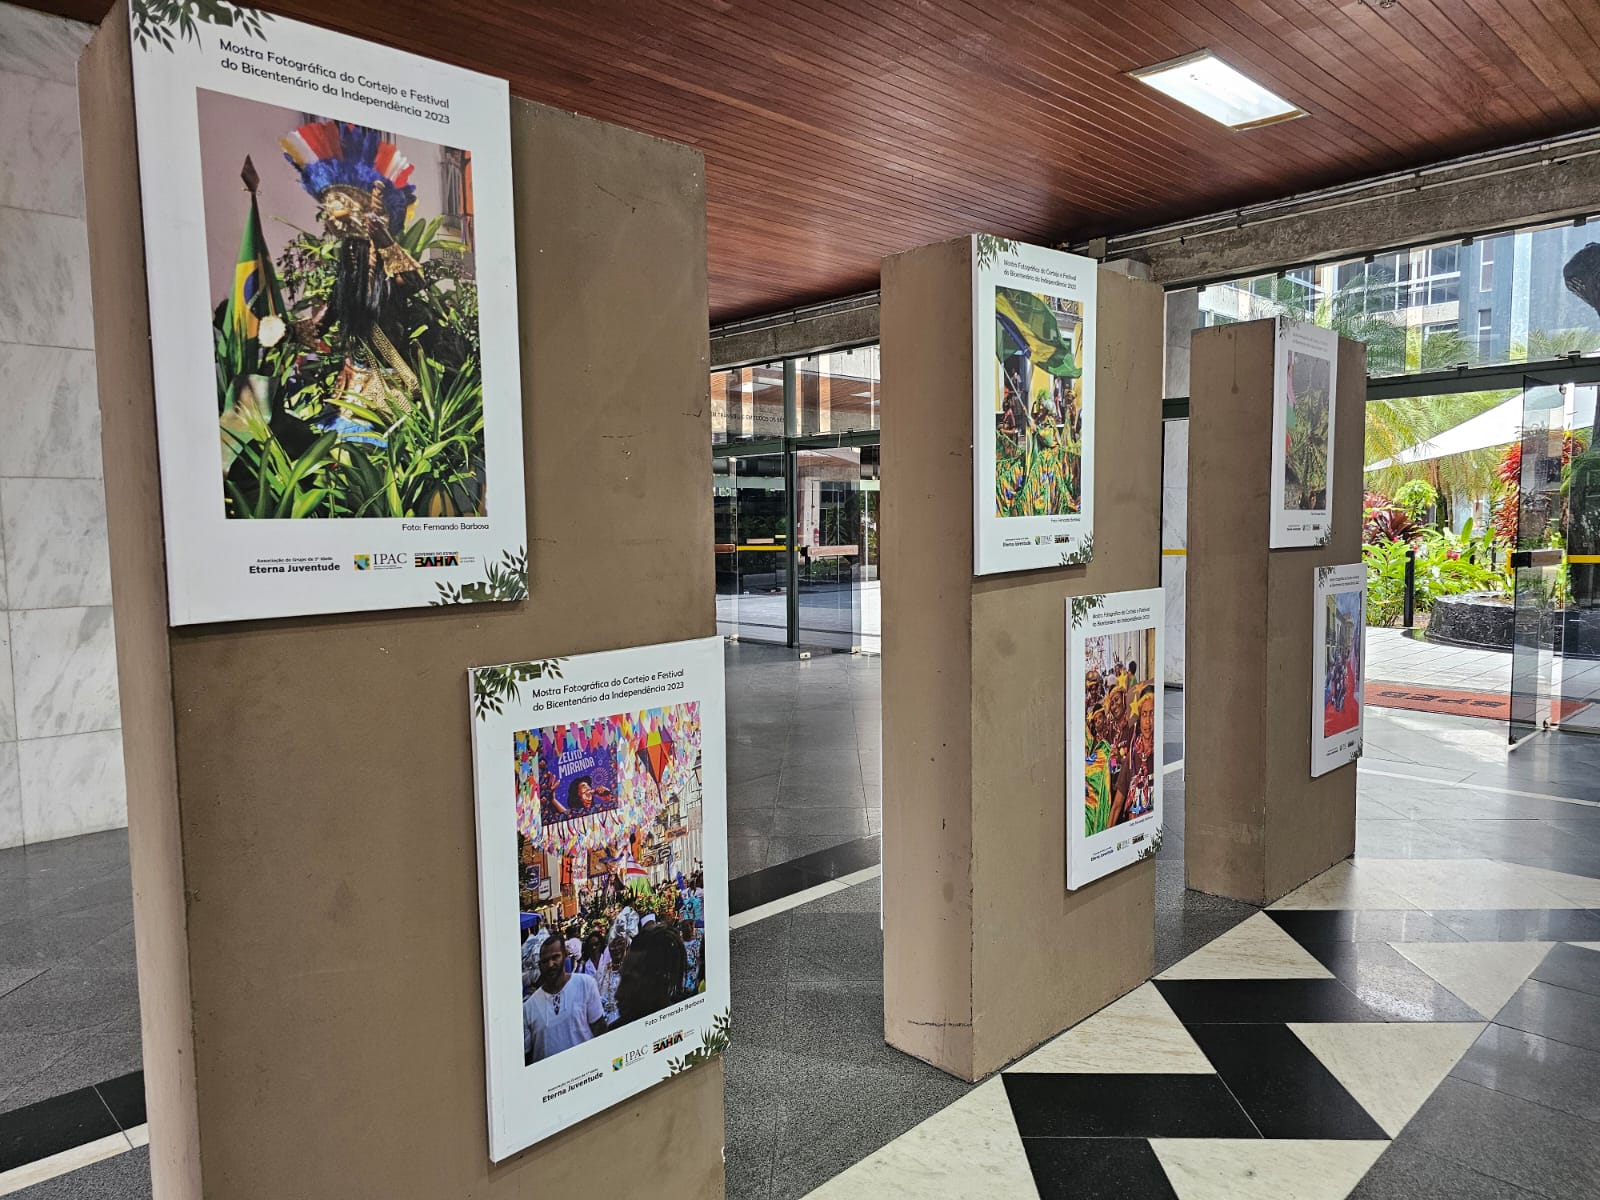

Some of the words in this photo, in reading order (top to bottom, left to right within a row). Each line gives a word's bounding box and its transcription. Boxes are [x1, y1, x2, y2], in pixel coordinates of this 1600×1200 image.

[220, 38, 264, 60] Mostra
[267, 51, 336, 79] Fotográfica
[339, 71, 355, 84] do
[357, 75, 398, 96] Cortejo
[400, 88, 407, 98] e
[410, 89, 449, 109] Festival
[220, 58, 238, 71] do
[241, 62, 319, 91] Bicentenário
[322, 83, 338, 97] da
[341, 87, 422, 117] Independência
[424, 110, 450, 124] 2023
[402, 523, 421, 531] Foto:
[423, 523, 459, 531] Fernando
[460, 522, 489, 530] Barbosa
[249, 565, 285, 574] Eterna
[287, 562, 341, 573] Juventude
[373, 552, 408, 565] IPAC
[414, 555, 459, 568] BAHIA
[532, 688, 561, 698] Mostra
[563, 681, 609, 694] Fotográfica
[611, 679, 621, 687] do
[623, 675, 650, 685] Cortejo
[657, 669, 684, 680] Festival
[533, 702, 544, 712] do
[546, 694, 598, 710] Bicentenário
[599, 692, 610, 701] da
[611, 685, 666, 699] Independência
[667, 681, 685, 691] 2023
[558, 749, 583, 765] ZELITO
[558, 757, 596, 779] MIRANDA
[625, 1044, 648, 1063] IPAC
[653, 1031, 684, 1054] BAHIA
[542, 1089, 566, 1103] Eterna
[568, 1072, 604, 1092] Juventude
